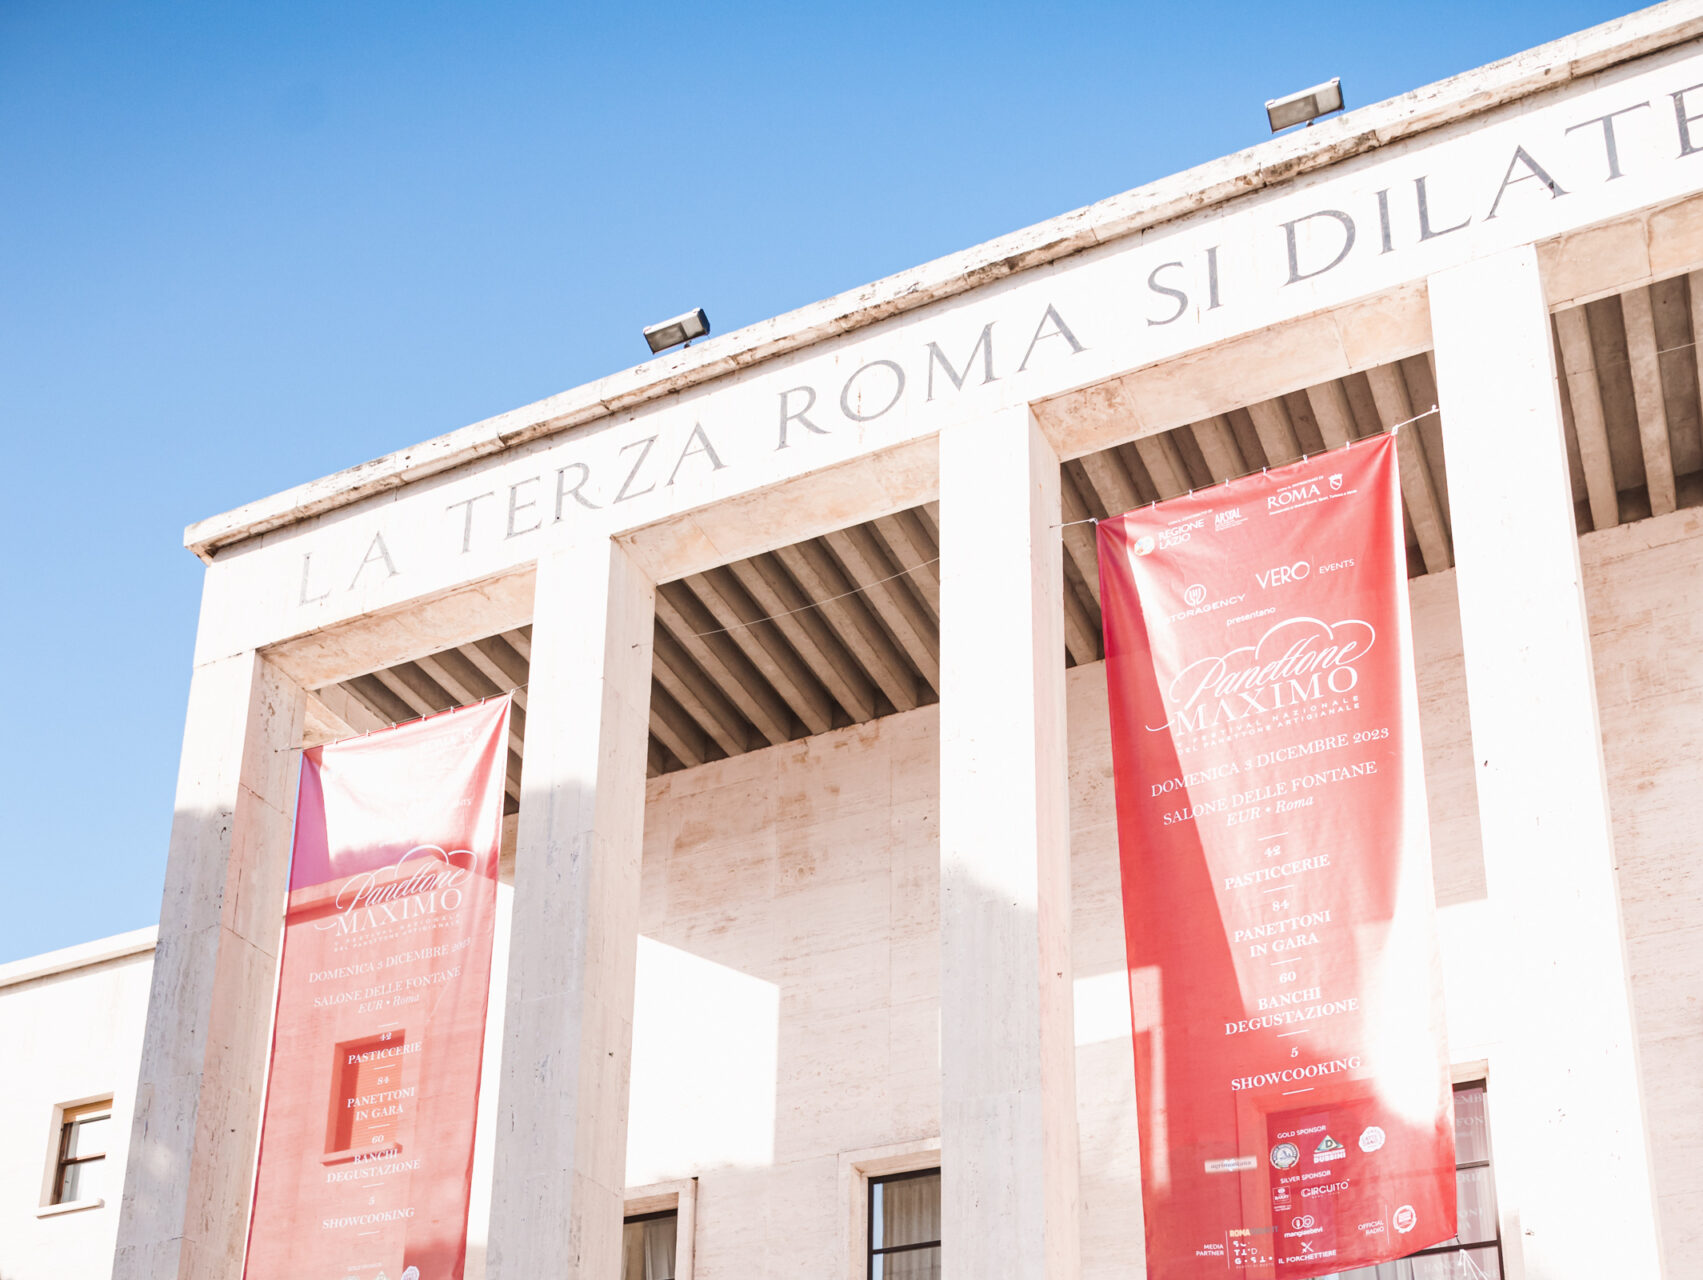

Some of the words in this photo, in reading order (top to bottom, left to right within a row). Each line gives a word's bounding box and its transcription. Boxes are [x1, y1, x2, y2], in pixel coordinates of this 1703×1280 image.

[298, 531, 400, 606] LA
[446, 422, 729, 552] TERZA
[775, 302, 1092, 450] ROMA
[1146, 246, 1224, 326] SI
[1267, 484, 1320, 509] ROMA
[1158, 519, 1205, 539] REGIONE
[1159, 533, 1191, 550] LAZIO
[1255, 561, 1310, 589] VERO
[1319, 558, 1355, 574] EVENTS
[1226, 606, 1276, 627] presentano
[1169, 617, 1375, 710] Panettone
[1172, 665, 1358, 737] MAXIMO
[1151, 762, 1240, 796] DOMENICA
[1244, 760, 1253, 771] 3
[1256, 733, 1349, 768] DICEMBRE
[1353, 727, 1389, 744] 2023
[1163, 799, 1228, 825] SALONE
[1232, 782, 1287, 808] DELLE
[1291, 761, 1377, 792] FONTANE
[1226, 806, 1261, 827] EUR
[1275, 795, 1314, 814] Roma
[1264, 845, 1281, 857] 42
[335, 844, 478, 916] Panettone
[1224, 854, 1331, 890] PASTICCERIE
[335, 888, 462, 937] MAXIMO
[1272, 899, 1289, 912] 84
[1234, 910, 1331, 943] PANETTONI
[1250, 943, 1268, 958] IN
[1272, 932, 1319, 952] GARA
[308, 962, 375, 983] DOMENICA
[385, 944, 449, 968] DICEMBRE
[313, 990, 362, 1008] SALONE
[365, 981, 403, 999] DELLE
[406, 966, 462, 989] FONTANE
[1279, 971, 1297, 984] 60
[358, 999, 383, 1014] EUR
[1257, 986, 1322, 1011] BANCHI
[1225, 998, 1360, 1035] DEGUSTAZIONE
[348, 1041, 422, 1065] PASTICCERIE
[1290, 1046, 1299, 1058] 5
[1231, 1056, 1361, 1091] SHOWCOOKING
[347, 1087, 415, 1108] PANETTONI
[356, 1110, 369, 1121] IN
[371, 1104, 403, 1119] GARA
[371, 1135, 384, 1144] 60
[1277, 1130, 1295, 1139] GOLD
[1296, 1125, 1327, 1136] SPONSOR
[353, 1148, 398, 1165] BANCHI
[326, 1159, 421, 1184] DEGUSTAZIONE
[1280, 1176, 1300, 1184] SILVER
[1301, 1181, 1348, 1198] CIRCUITO
[322, 1207, 415, 1229] SHOWCOOKING
